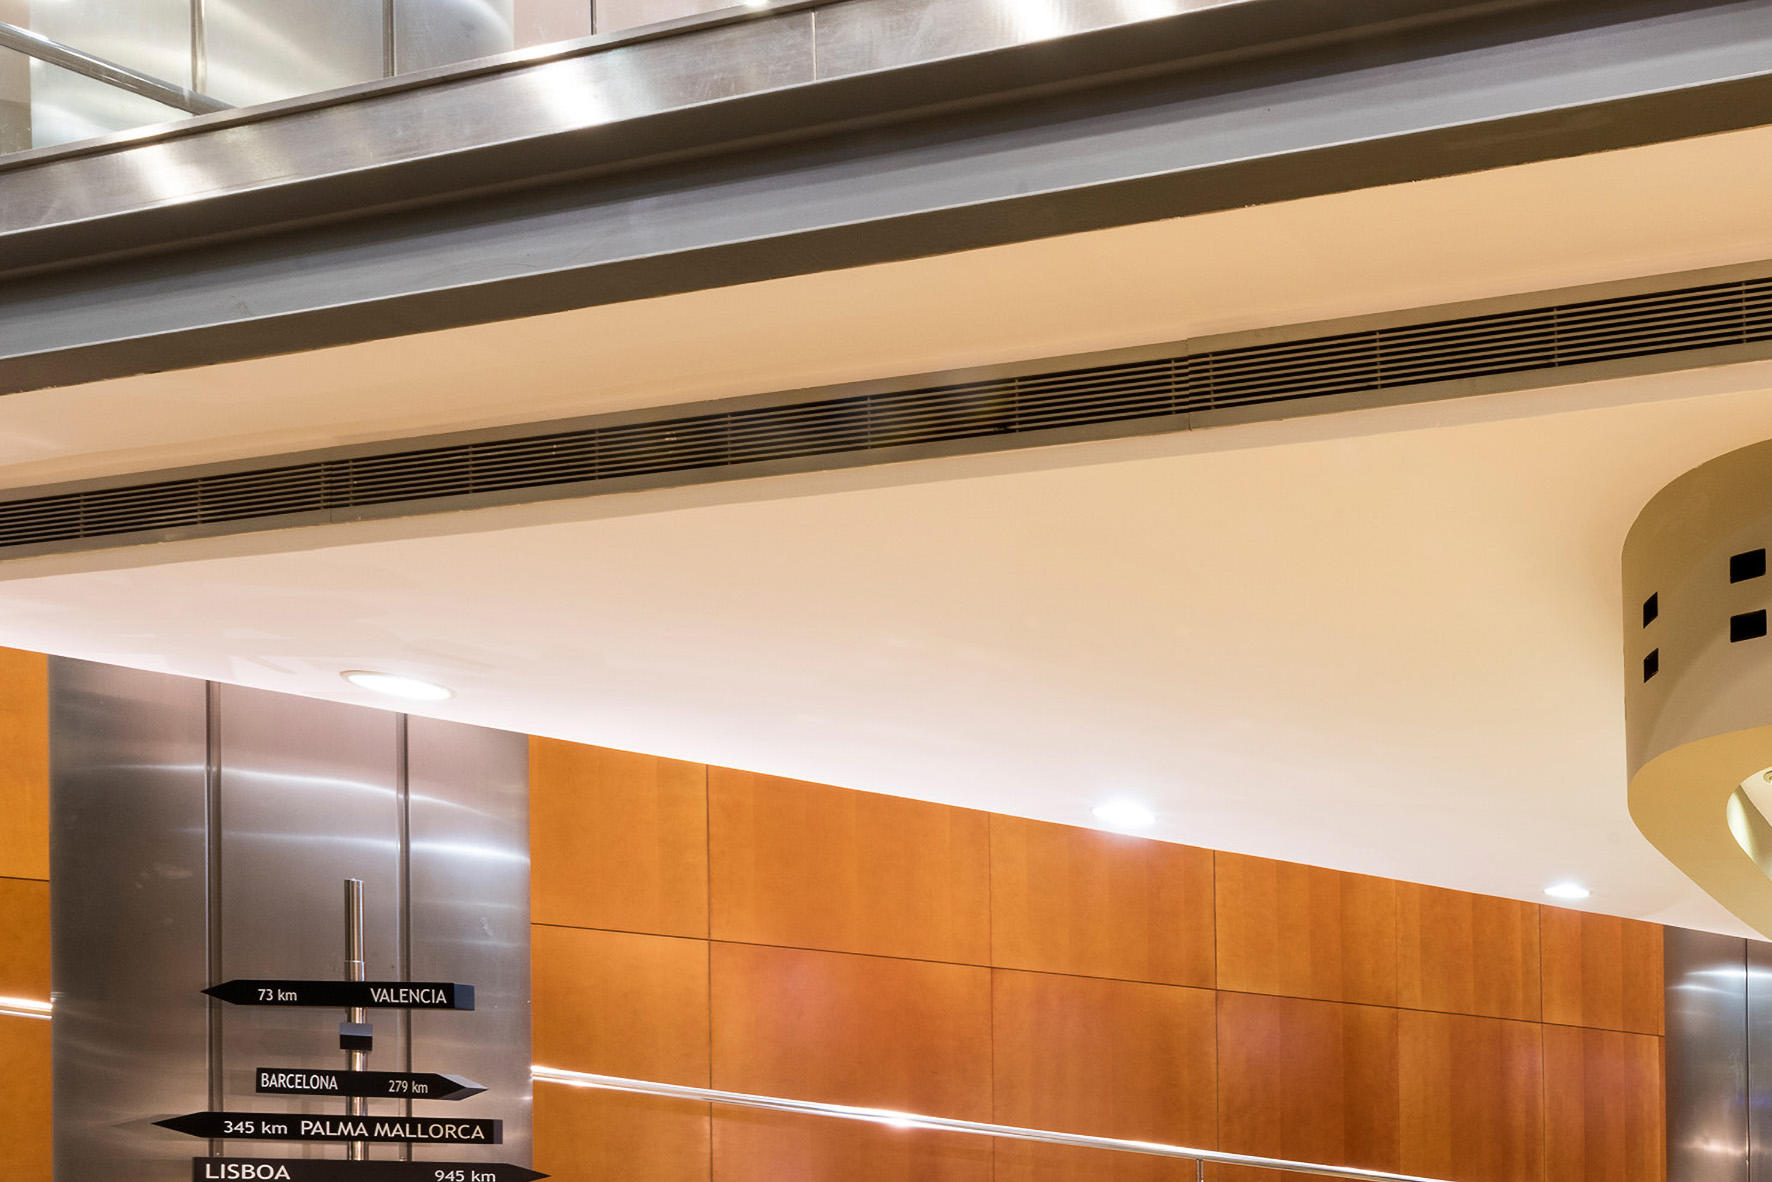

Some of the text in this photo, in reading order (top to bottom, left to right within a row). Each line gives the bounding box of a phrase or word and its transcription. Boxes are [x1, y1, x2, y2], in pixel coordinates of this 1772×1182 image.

[258, 987, 447, 1004] 73 km VALENCIA
[260, 1072, 428, 1094] BARCELONA 279 km
[223, 1120, 485, 1140] 345 km PALMA MALLORCA
[205, 1162, 496, 1182] LISBOA 945 km
